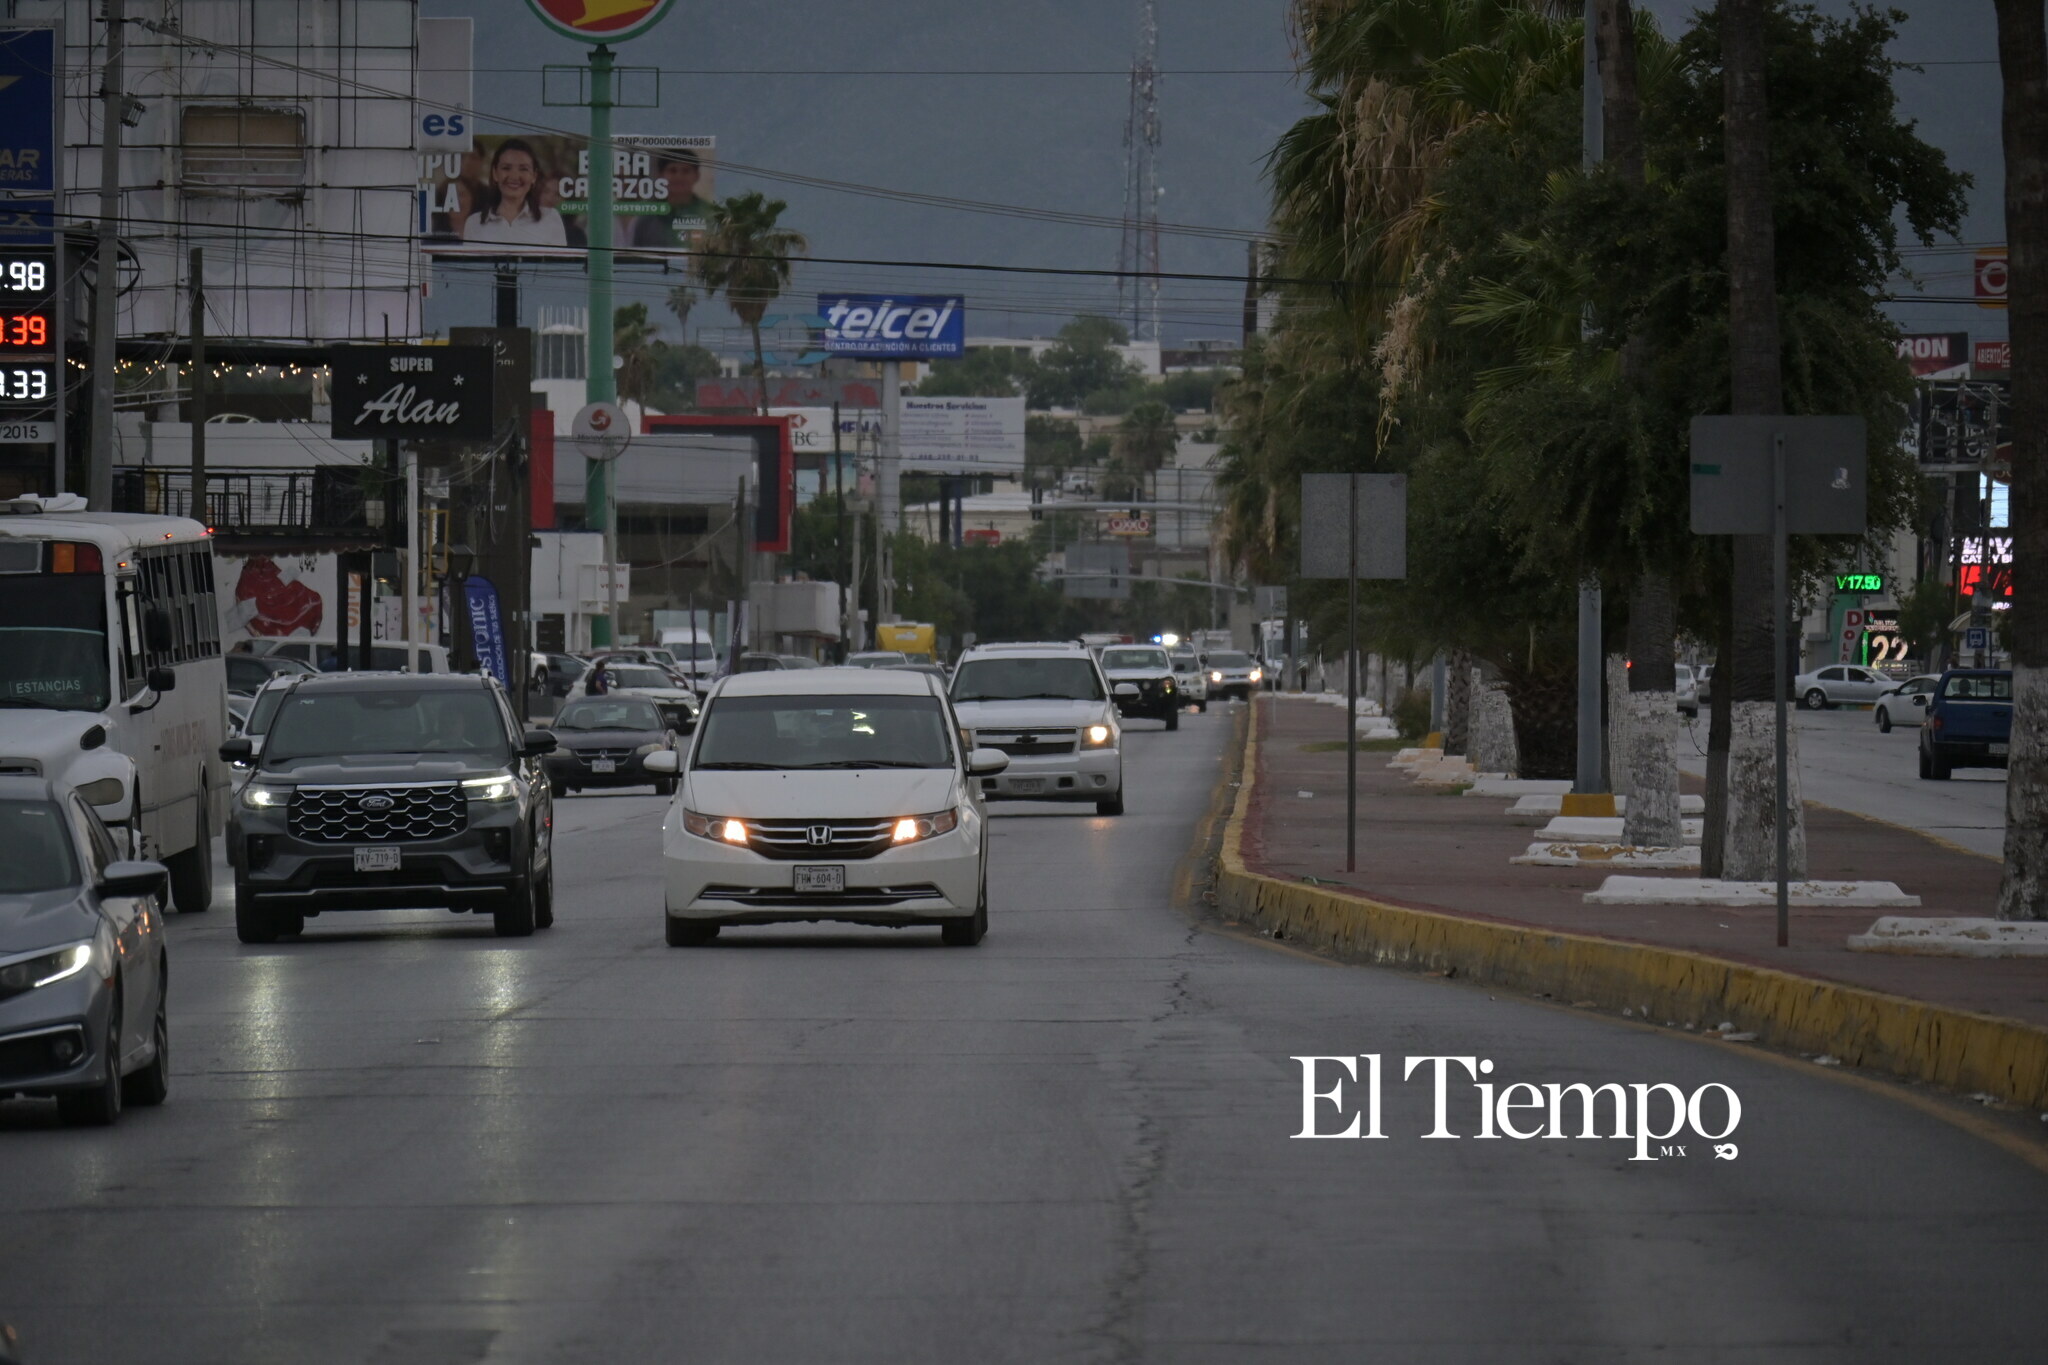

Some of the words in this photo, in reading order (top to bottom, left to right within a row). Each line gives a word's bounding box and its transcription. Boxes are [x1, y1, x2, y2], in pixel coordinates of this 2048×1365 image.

[0, 148, 41, 169] AR
[0, 170, 33, 181] ERAS
[559, 176, 669, 199] CAAZOS
[0, 262, 46, 292] .98
[0, 316, 47, 345] .39
[825, 299, 957, 340] telcel
[1897, 337, 1949, 360] RON
[390, 357, 434, 372] SUPER
[0, 370, 47, 400] .33
[353, 382, 460, 426] Alan
[795, 431, 818, 447] BC
[469, 596, 493, 671] STONIC
[15, 679, 81, 695] ESTANCIAS
